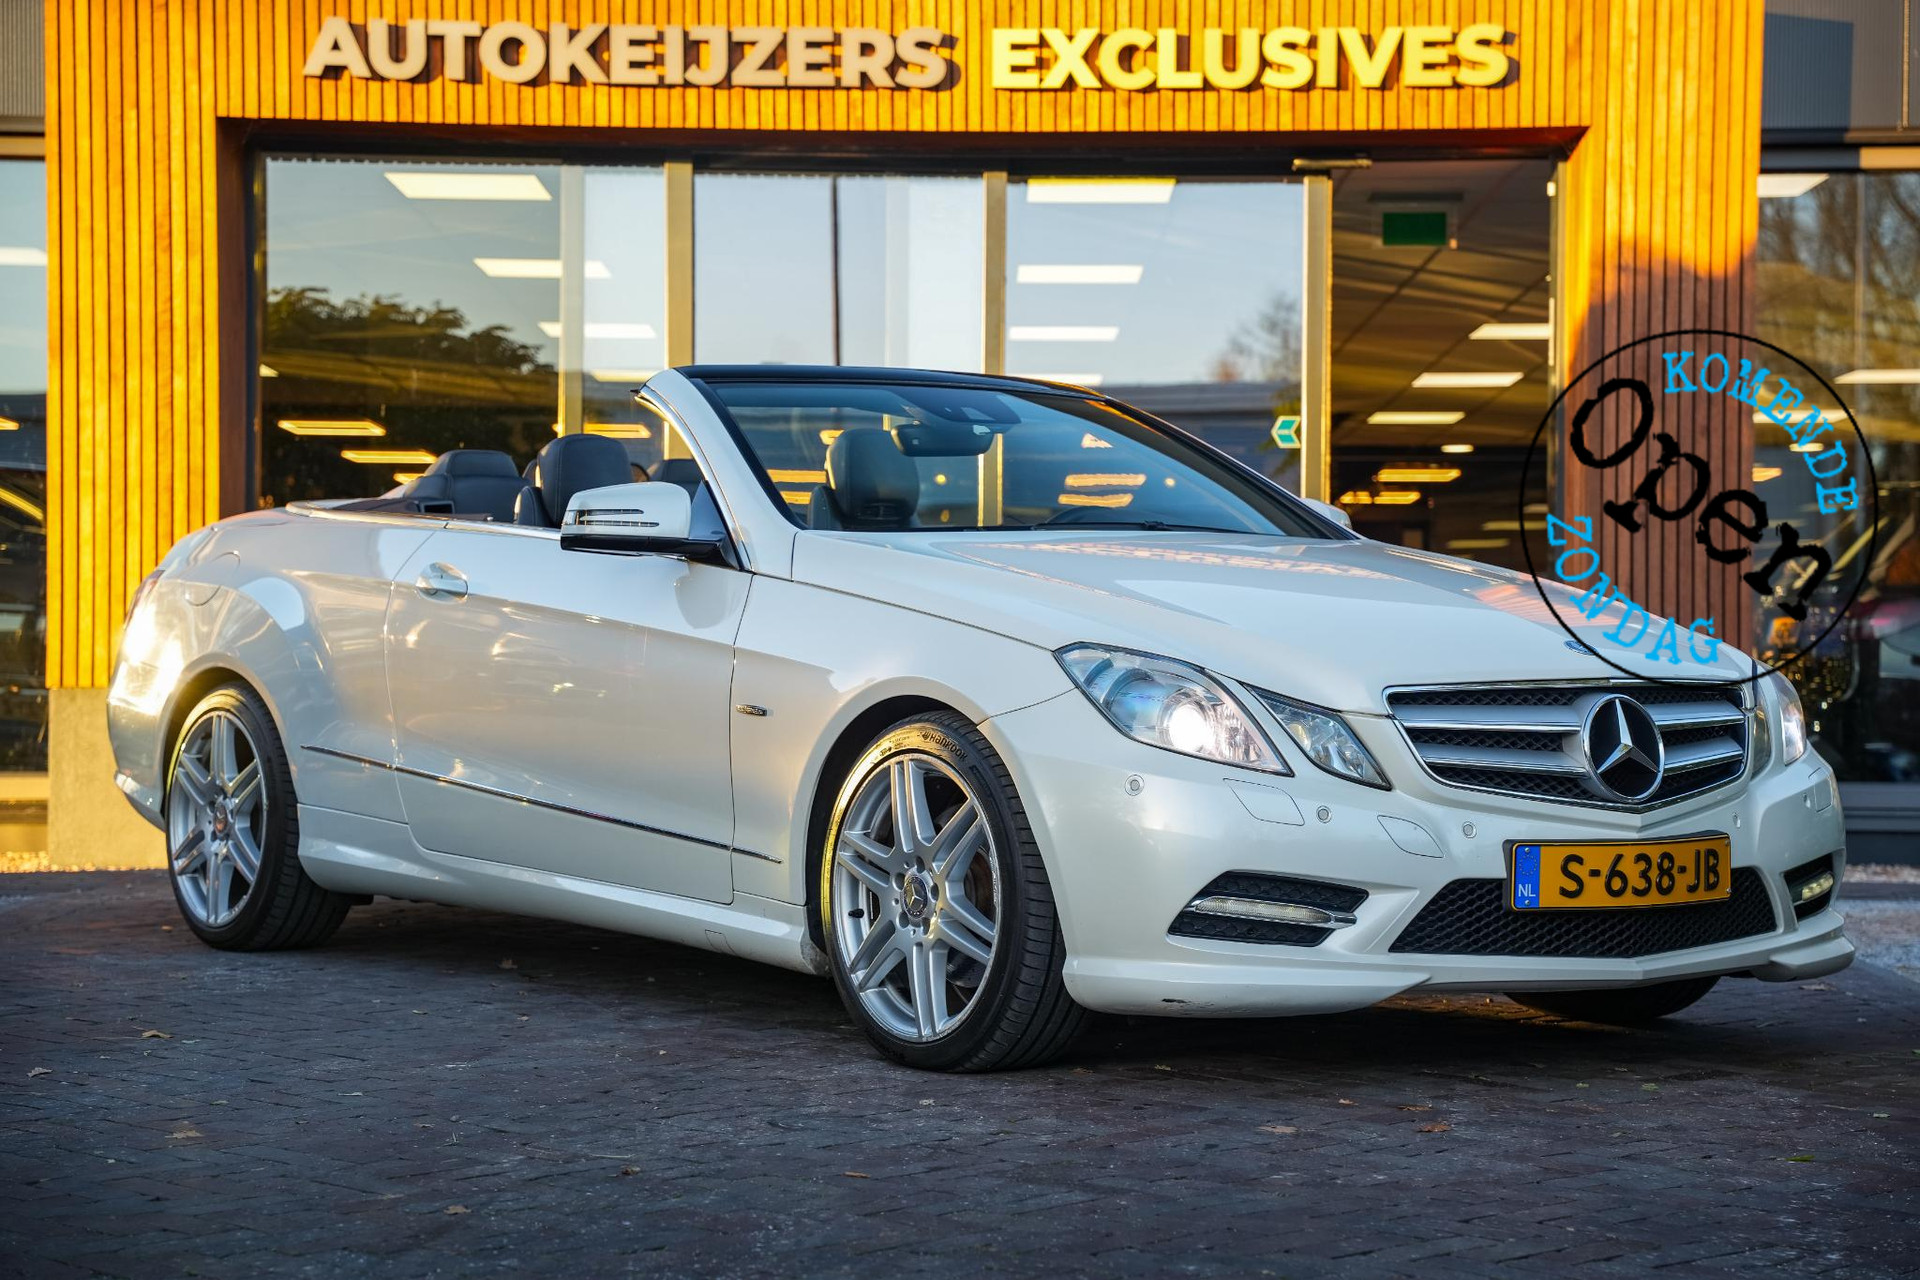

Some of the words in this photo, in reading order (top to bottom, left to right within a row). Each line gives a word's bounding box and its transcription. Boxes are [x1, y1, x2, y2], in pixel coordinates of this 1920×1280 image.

[302, 16, 949, 88] AUTOKEIJZERS
[991, 24, 1511, 90] EXCLUSIVES
[1518, 883, 1536, 897] NL
[1559, 848, 1720, 899] S-638-JB
